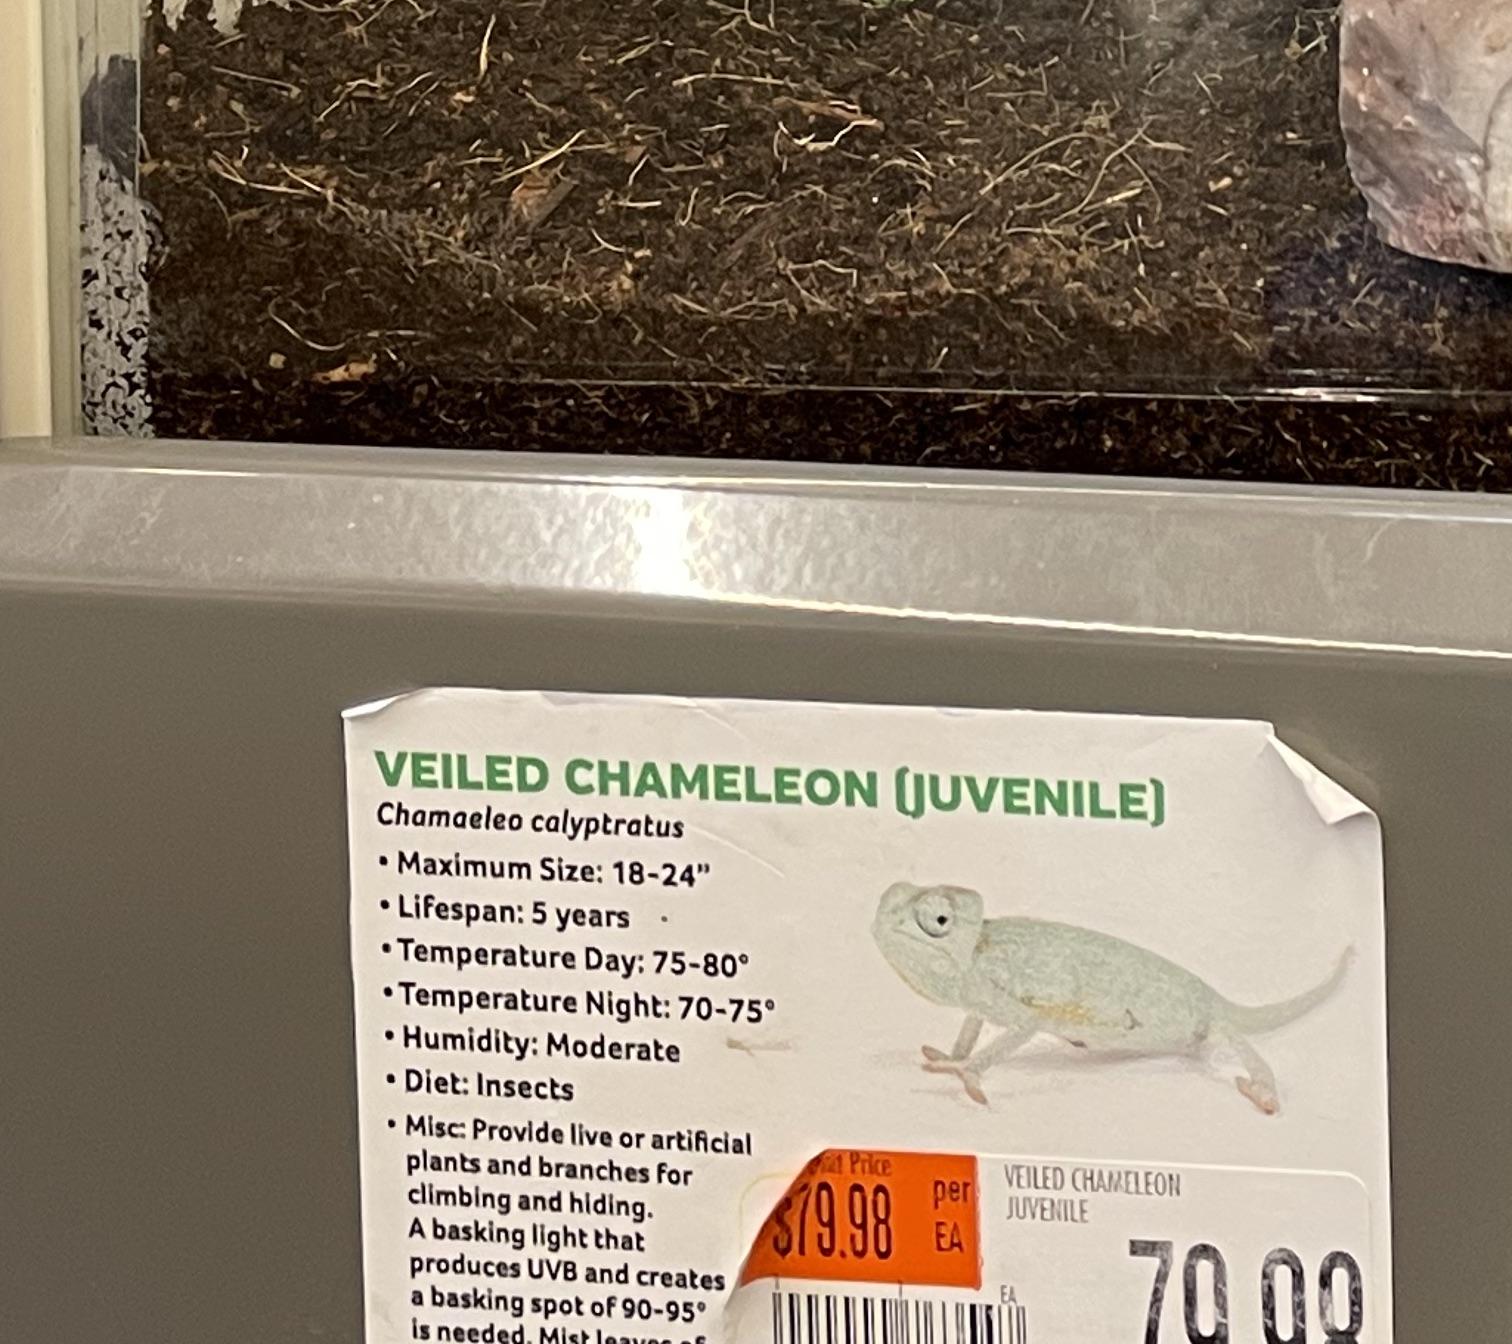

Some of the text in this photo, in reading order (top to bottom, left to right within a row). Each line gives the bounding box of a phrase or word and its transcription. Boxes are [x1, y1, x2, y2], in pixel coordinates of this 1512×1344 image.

[374, 750, 1165, 828] VEILED CHAMELEON (JUVENILE)
[376, 801, 686, 841] Chamaeleo calyptratus
[397, 850, 532, 881] Maximum
[540, 857, 604, 885] Size:
[399, 893, 631, 933] Lifespan: 5 years
[397, 938, 577, 971] Temperature
[584, 947, 645, 979] Day:
[398, 982, 578, 1014] Temperature
[585, 991, 671, 1023] Night:
[402, 1025, 681, 1063] Humidity: Moderate
[404, 1069, 575, 1102] Diet: Insects
[405, 1114, 752, 1156] Misc: Provide live or artificial
[406, 1149, 694, 1187] plants and branches for
[849, 1150, 893, 1177] Price
[1004, 1164, 1181, 1197] VEILED CHAMELEON
[407, 1182, 654, 1224] climbing and hiding.
[933, 1179, 972, 1209] per
[1006, 1197, 1089, 1223] JUVENILE
[408, 1217, 646, 1254] A basking light that
[772, 1180, 893, 1261] $79.98
[934, 1221, 965, 1254] EA
[410, 1252, 726, 1291] produces UVB and creates
[411, 1289, 424, 1307] a
[431, 1285, 524, 1318] basking
[531, 1295, 584, 1321] spot
[590, 1296, 617, 1319] of
[1001, 1285, 1018, 1305] EA
[412, 1317, 430, 1340] is
[437, 1322, 532, 1344] needed.
[539, 1326, 590, 1344] Mist
